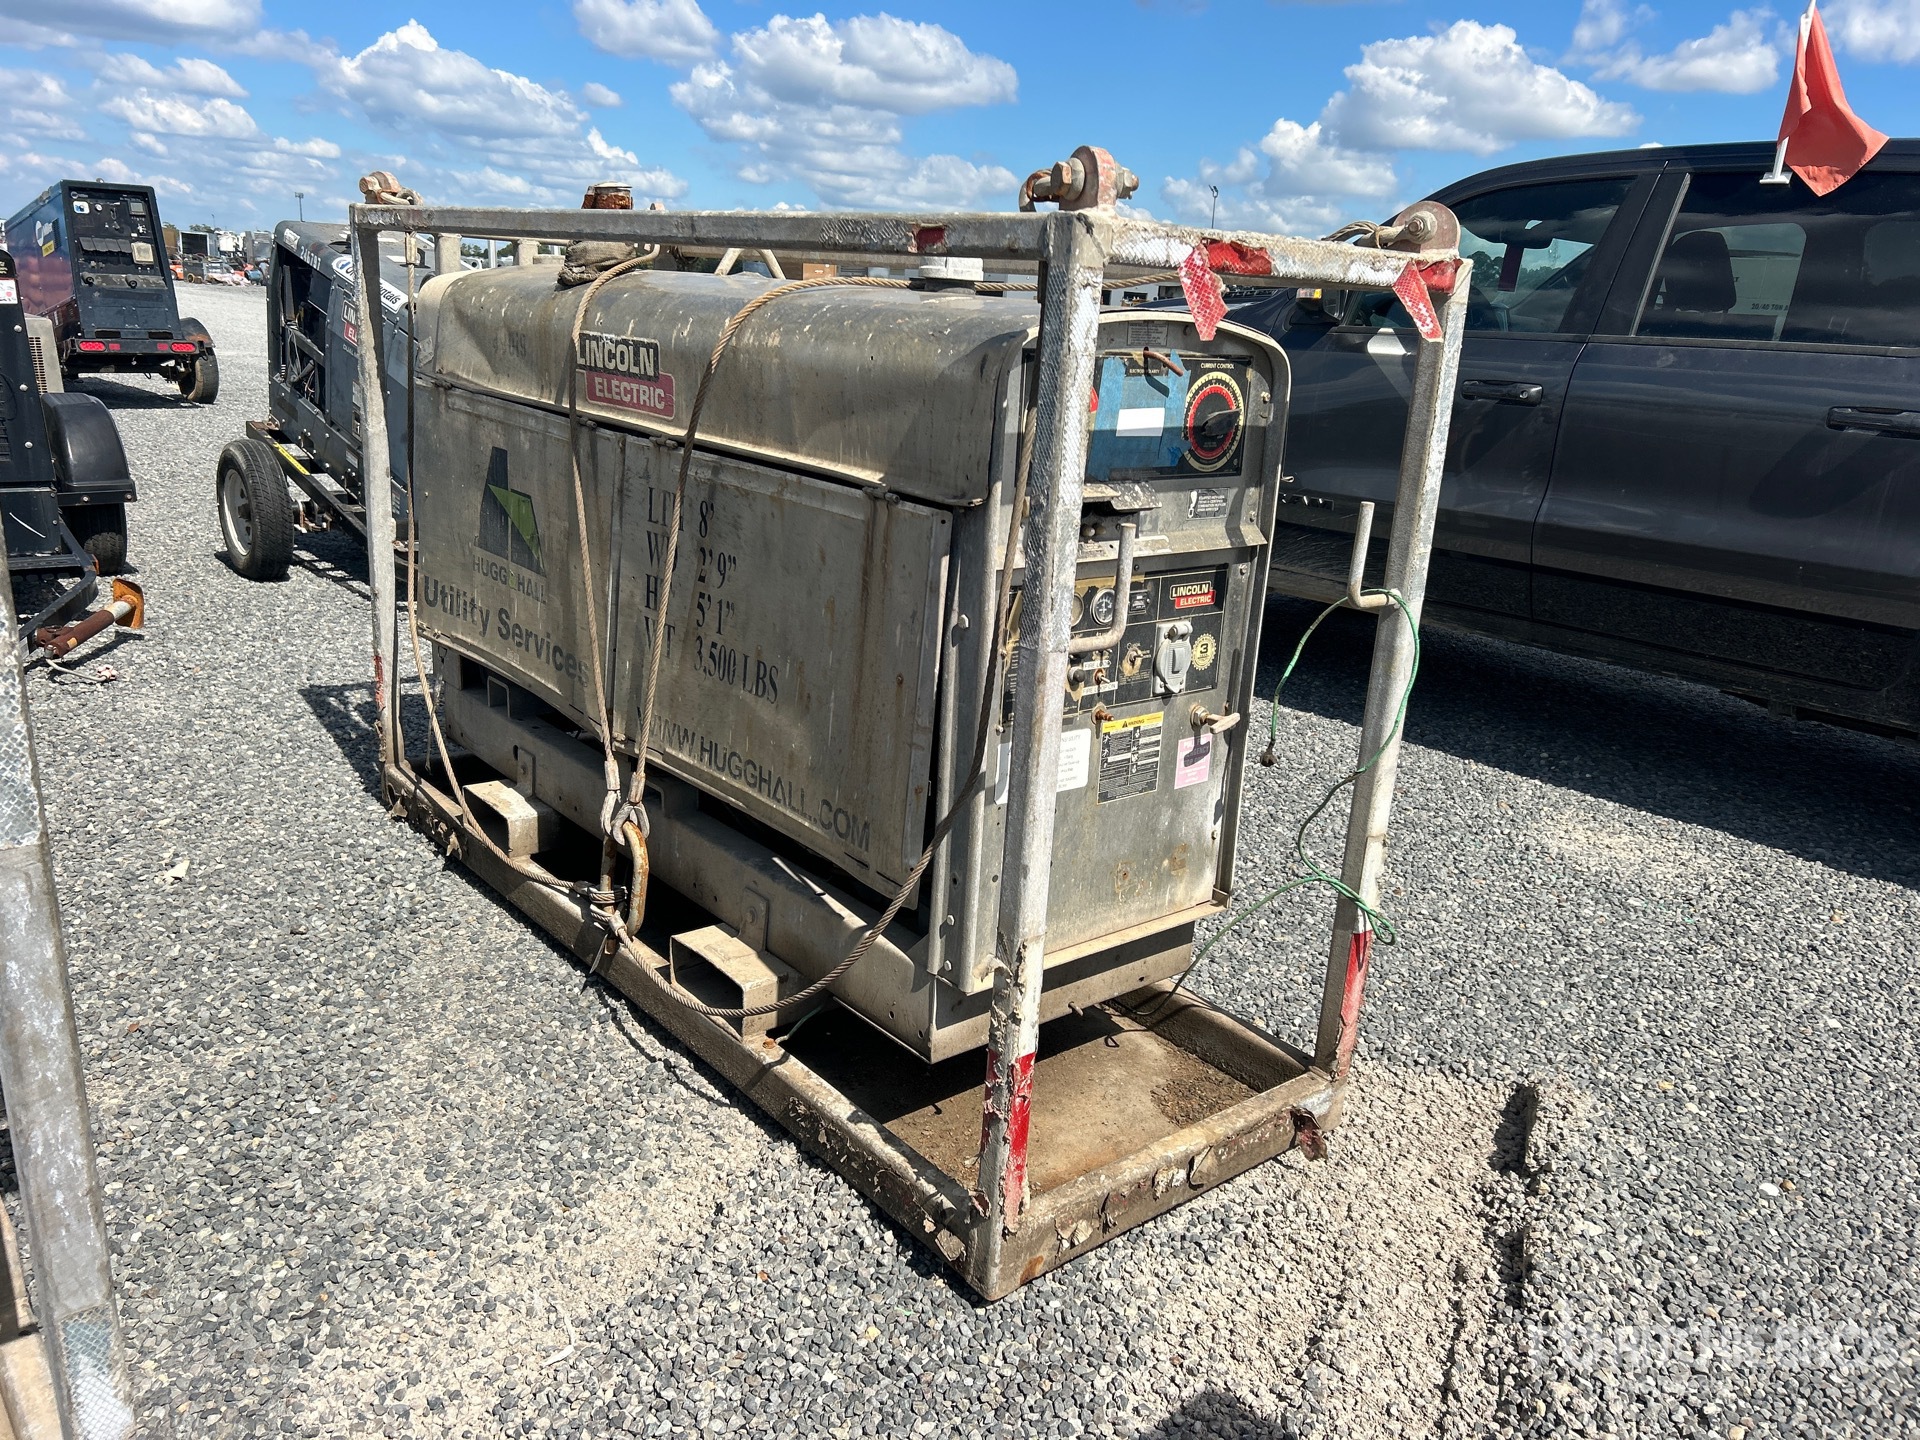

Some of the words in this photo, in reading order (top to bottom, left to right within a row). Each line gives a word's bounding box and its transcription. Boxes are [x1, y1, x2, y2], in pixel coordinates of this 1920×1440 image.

[577, 340, 655, 377] LINCOLN
[594, 377, 665, 410] ELECTRIC
[1172, 584, 1209, 598] LINCOLN
[1180, 595, 1212, 606] ELECTRIC
[424, 575, 490, 638] Utility
[497, 607, 590, 688] Services
[1200, 643, 1209, 654] 3
[743, 653, 779, 704] LBS
